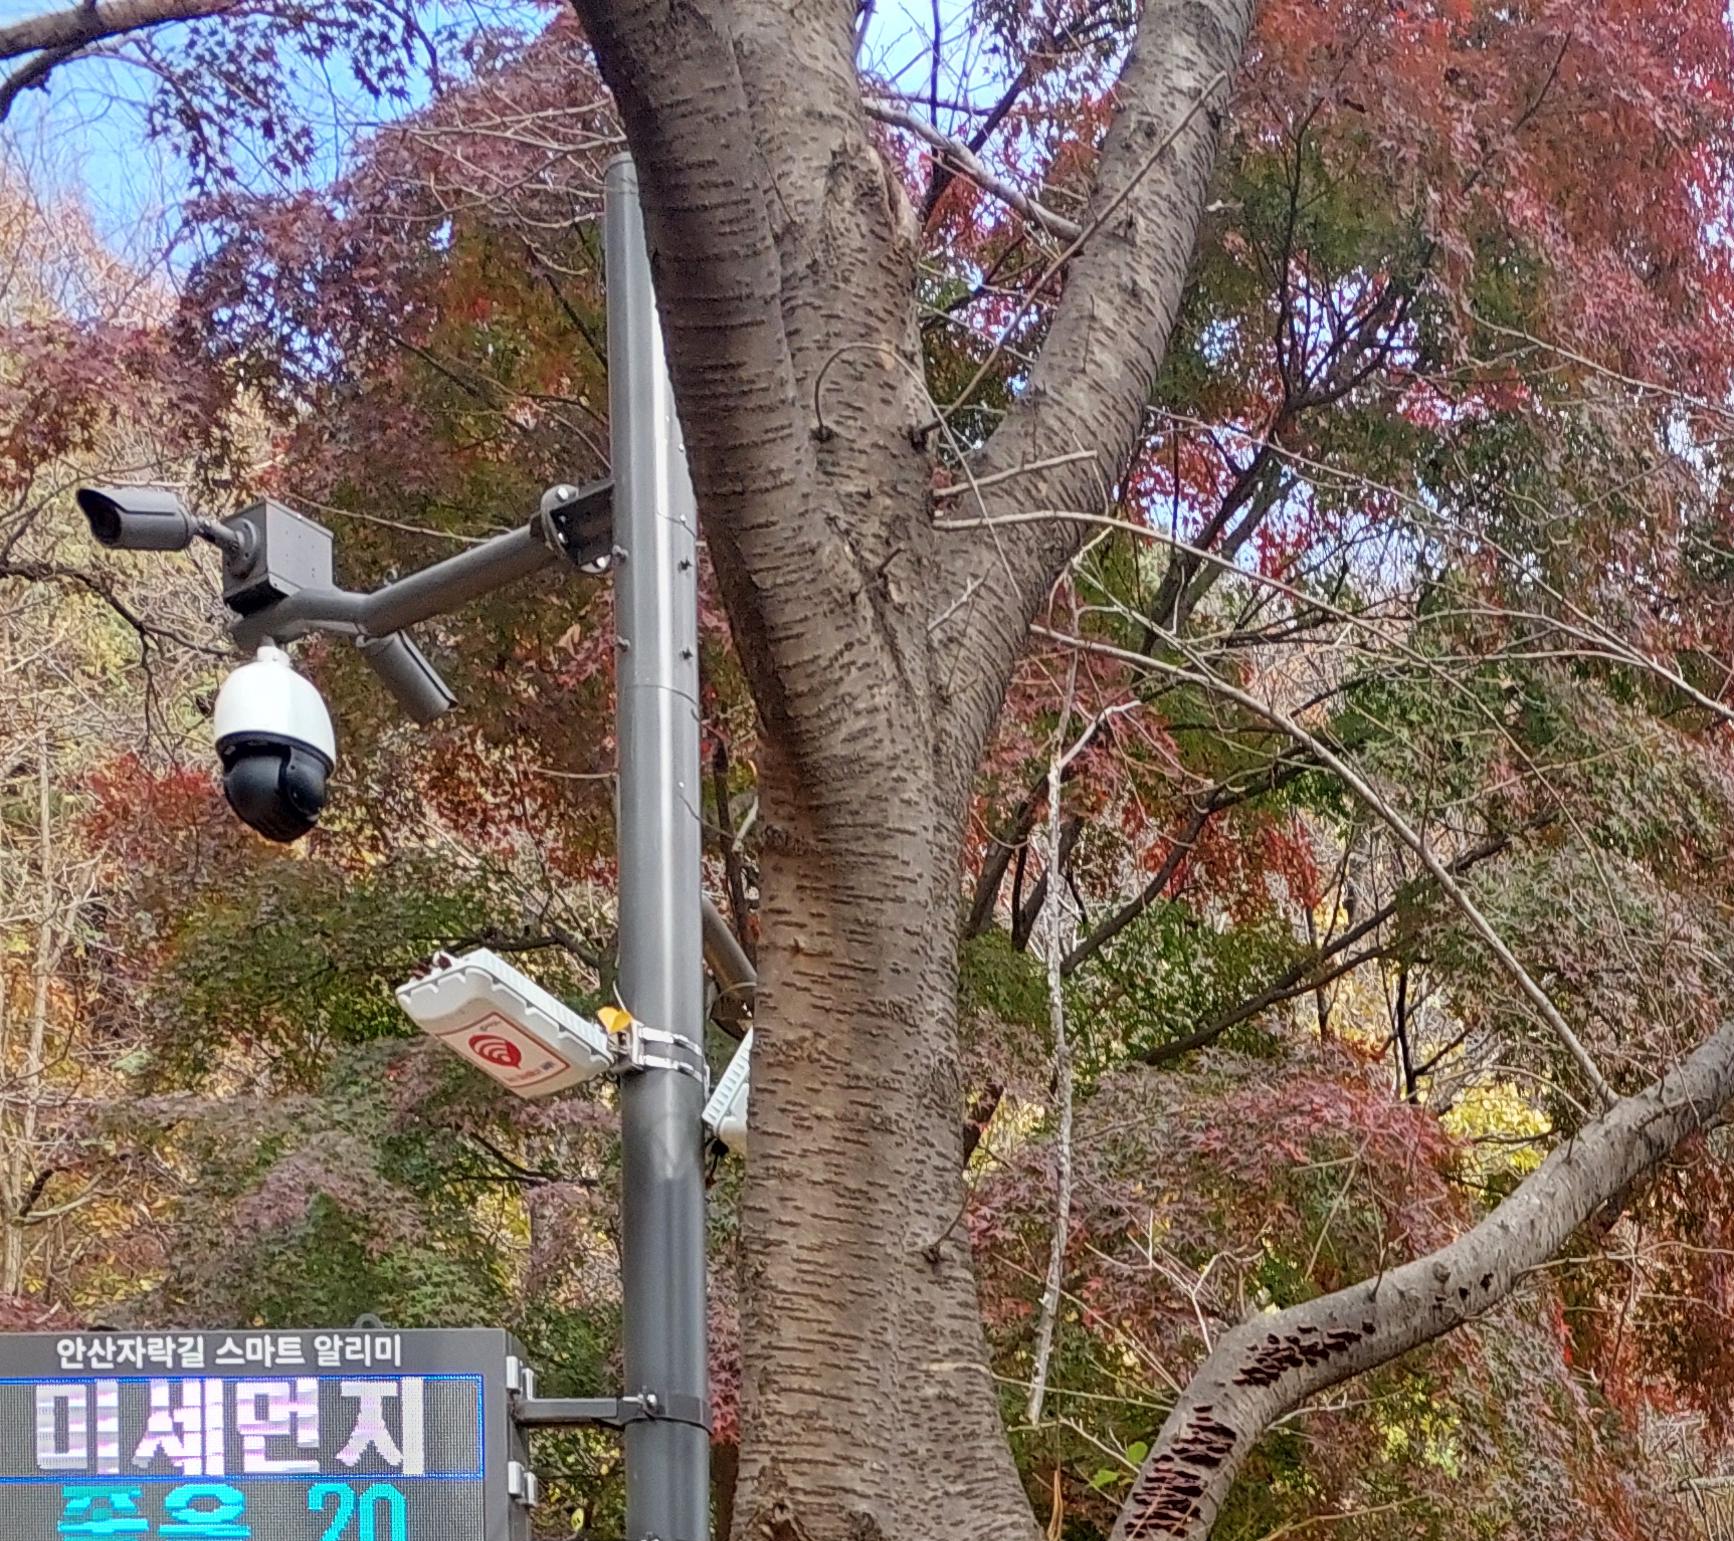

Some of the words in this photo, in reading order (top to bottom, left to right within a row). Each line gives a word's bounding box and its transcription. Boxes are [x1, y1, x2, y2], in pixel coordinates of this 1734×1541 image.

[56, 1335, 205, 1369] 안산자락길
[215, 1334, 306, 1368] 스마트
[313, 1333, 402, 1367] 알리미
[35, 1377, 425, 1476] 미세먼지
